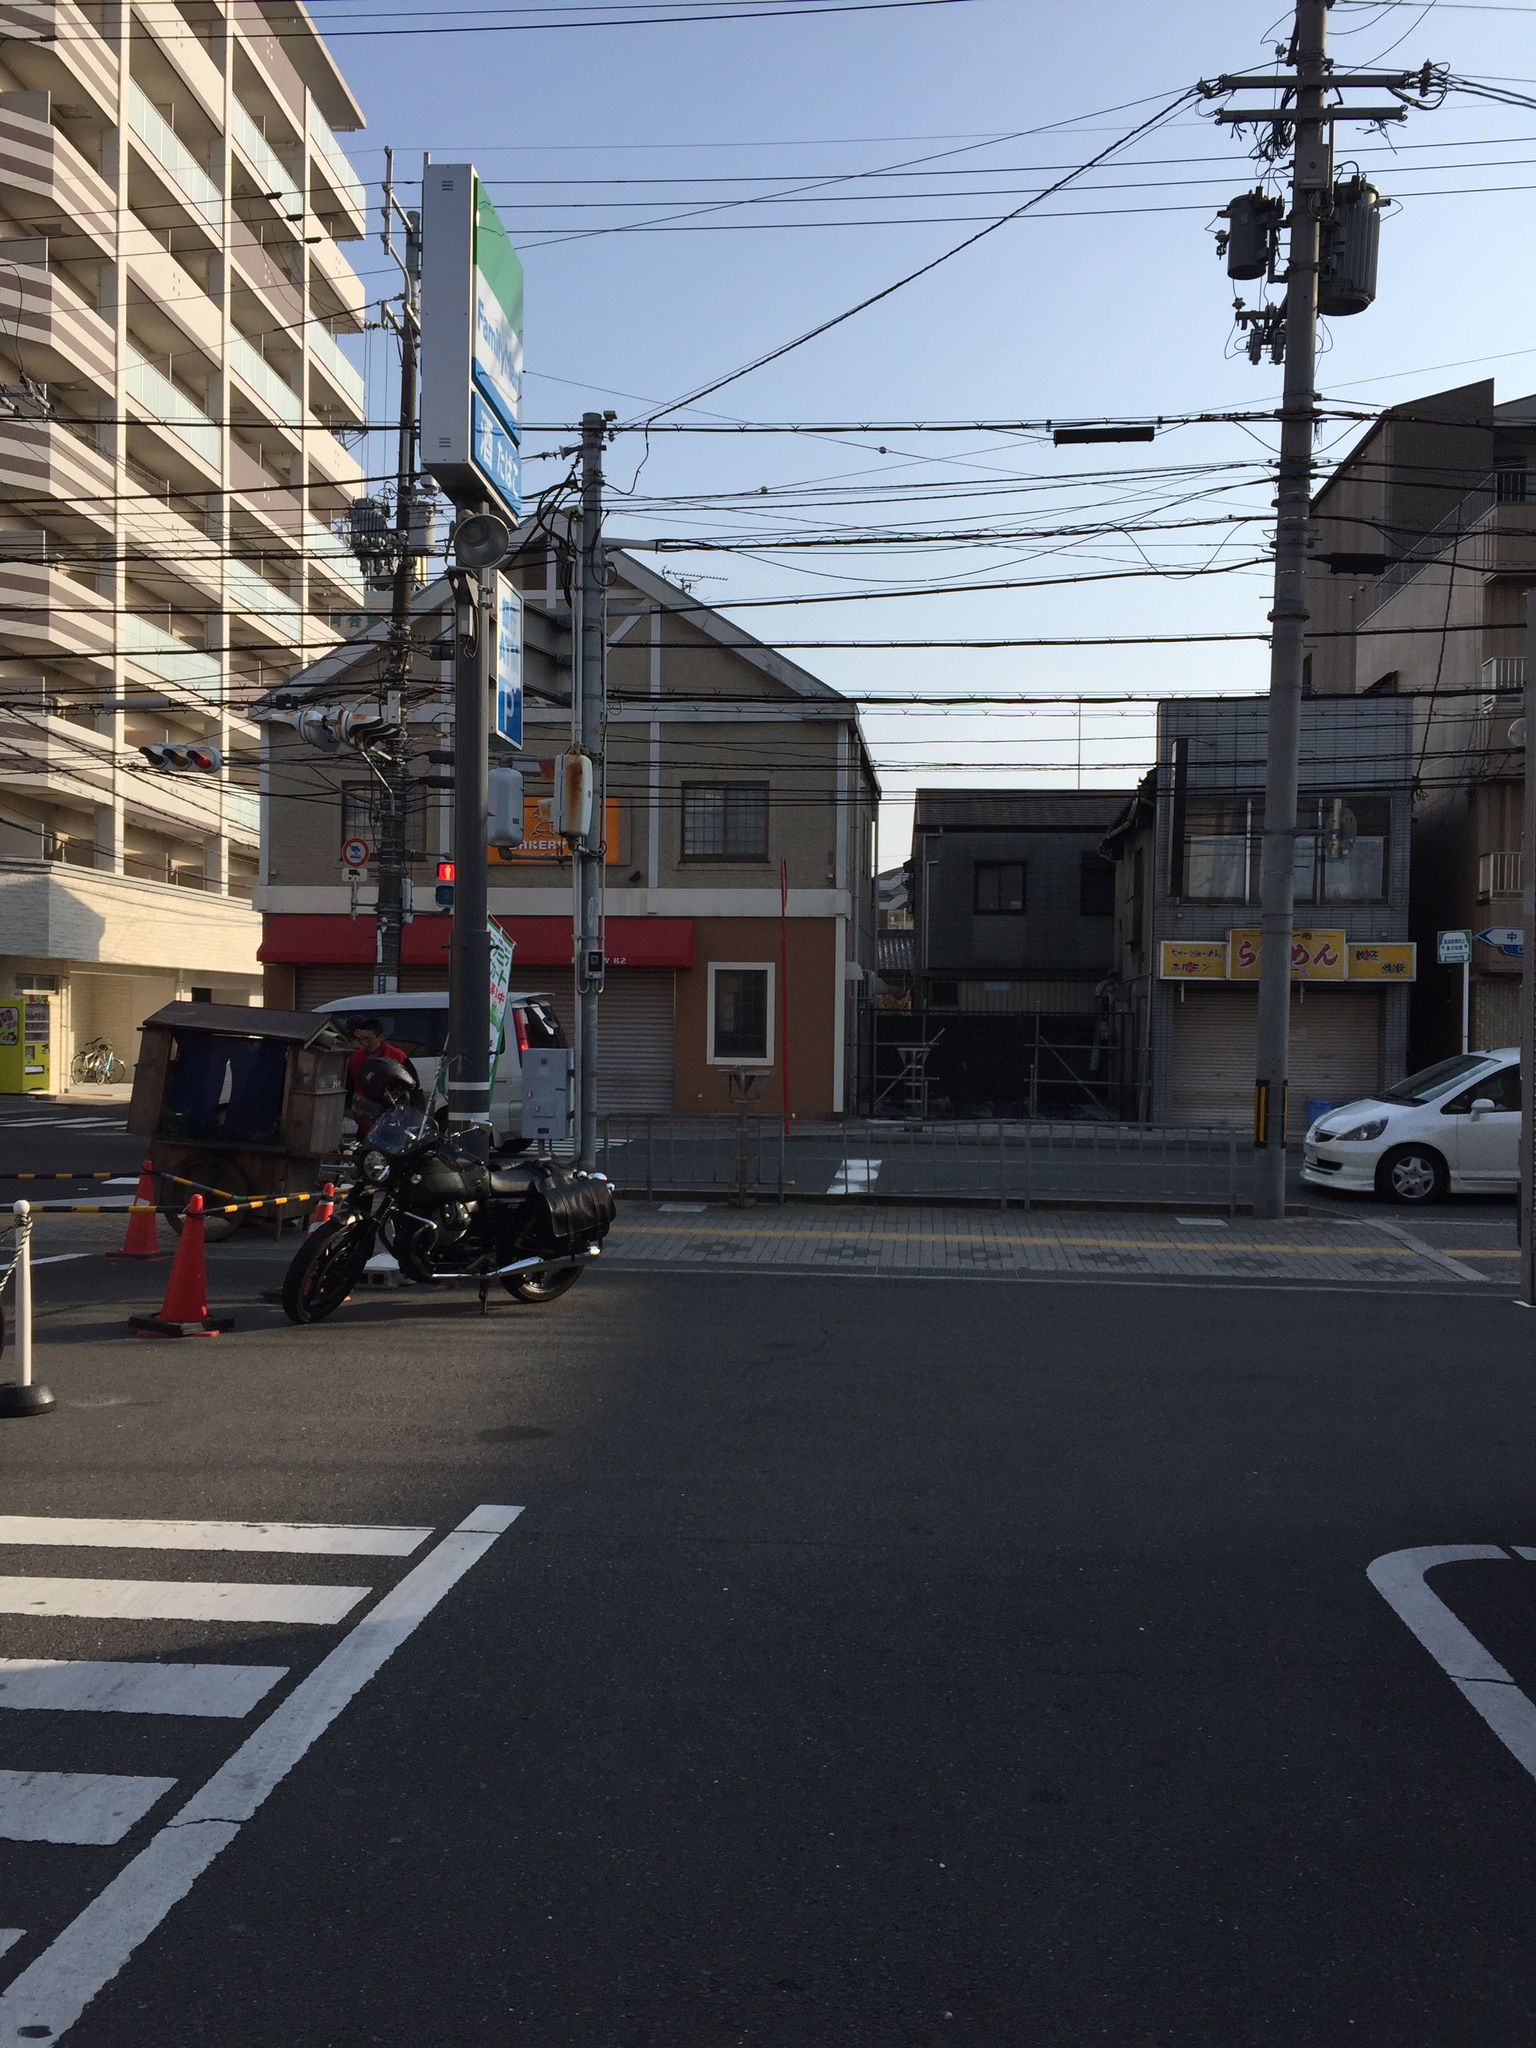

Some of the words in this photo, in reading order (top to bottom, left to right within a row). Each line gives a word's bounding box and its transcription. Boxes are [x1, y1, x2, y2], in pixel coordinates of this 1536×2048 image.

[480, 409, 493, 470] 酒
[497, 438, 519, 499] たばこ
[504, 684, 516, 733] P
[509, 840, 567, 850] AKERY
[1239, 940, 1338, 967] らめん
[1171, 962, 1210, 973] ホルモン
